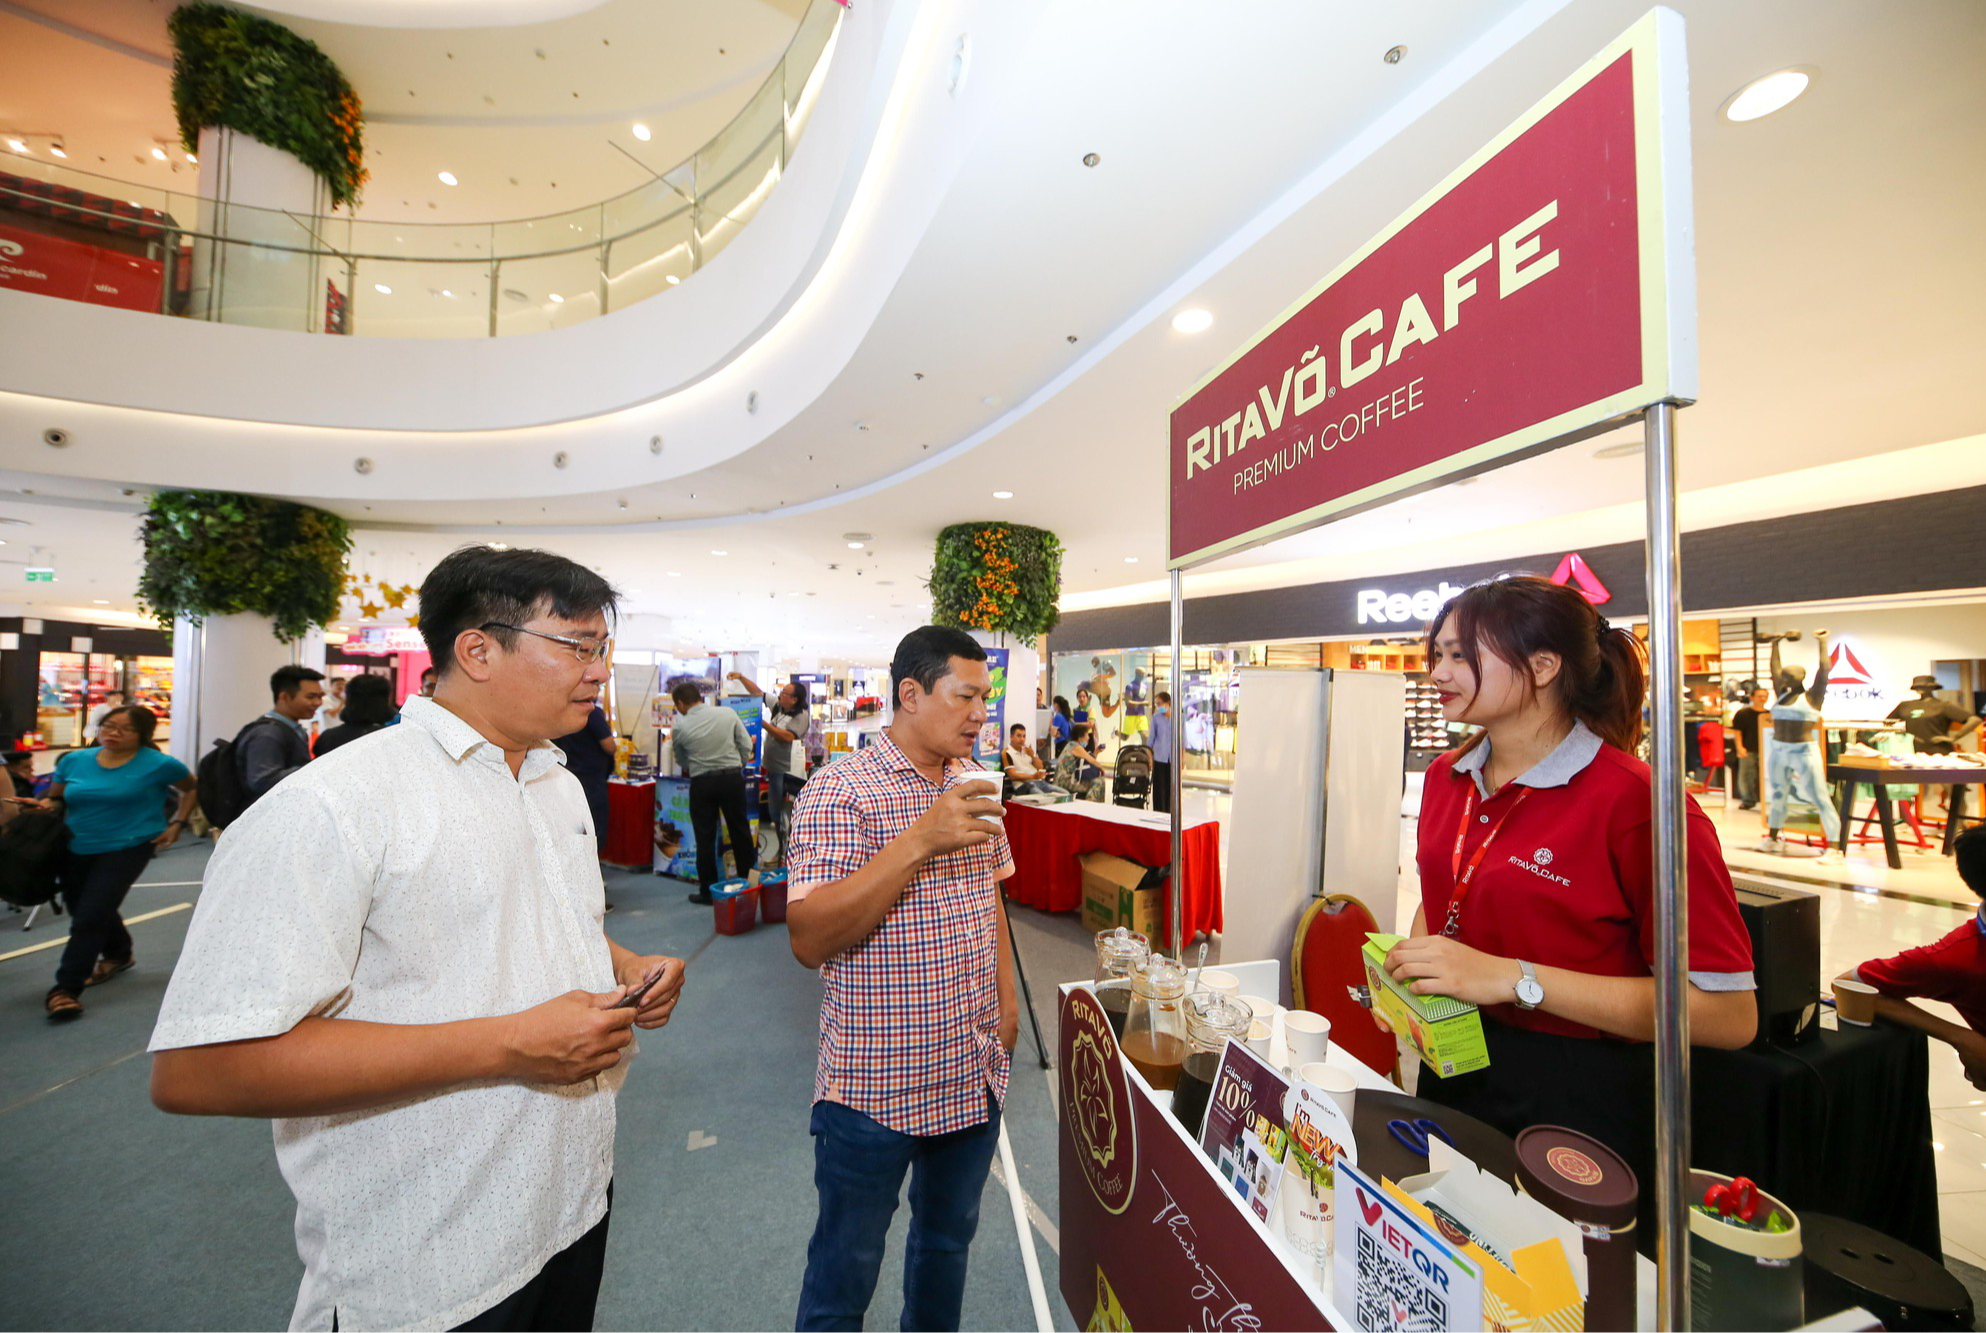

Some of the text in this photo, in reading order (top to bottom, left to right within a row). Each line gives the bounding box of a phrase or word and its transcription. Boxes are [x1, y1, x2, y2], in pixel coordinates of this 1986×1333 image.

[1340, 199, 1560, 389] CAFE
[1233, 376, 1424, 495] PREMIUM COFFEE
[1540, 868, 1571, 887] CAFE
[1218, 1076, 1257, 1128] 10%
[1241, 1080, 1252, 1093] giá
[1289, 1113, 1343, 1163] NEW
[1355, 1186, 1450, 1295] VIETQR
